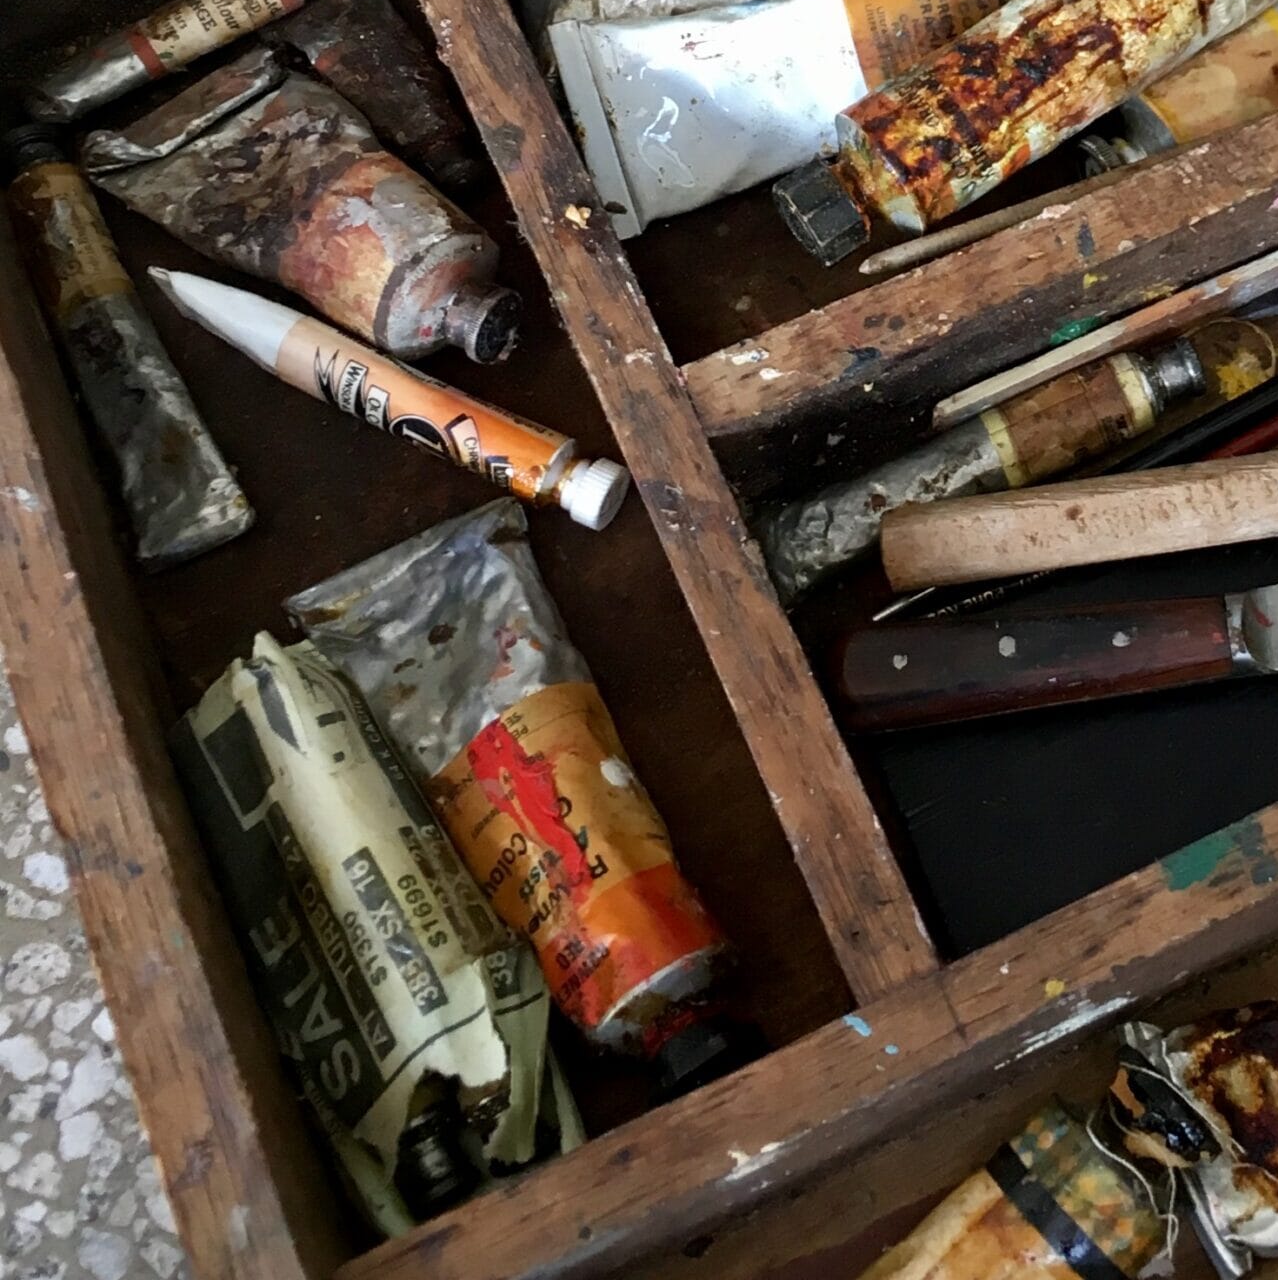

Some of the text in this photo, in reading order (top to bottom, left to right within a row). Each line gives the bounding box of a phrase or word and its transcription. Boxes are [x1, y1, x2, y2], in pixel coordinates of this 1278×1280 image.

[344, 856, 380, 894] 16
[478, 831, 528, 898] Colou
[298, 878, 354, 981] TURBO
[392, 870, 453, 950] $1699
[244, 894, 367, 1101] SALE
[358, 1004, 393, 1046] AT
